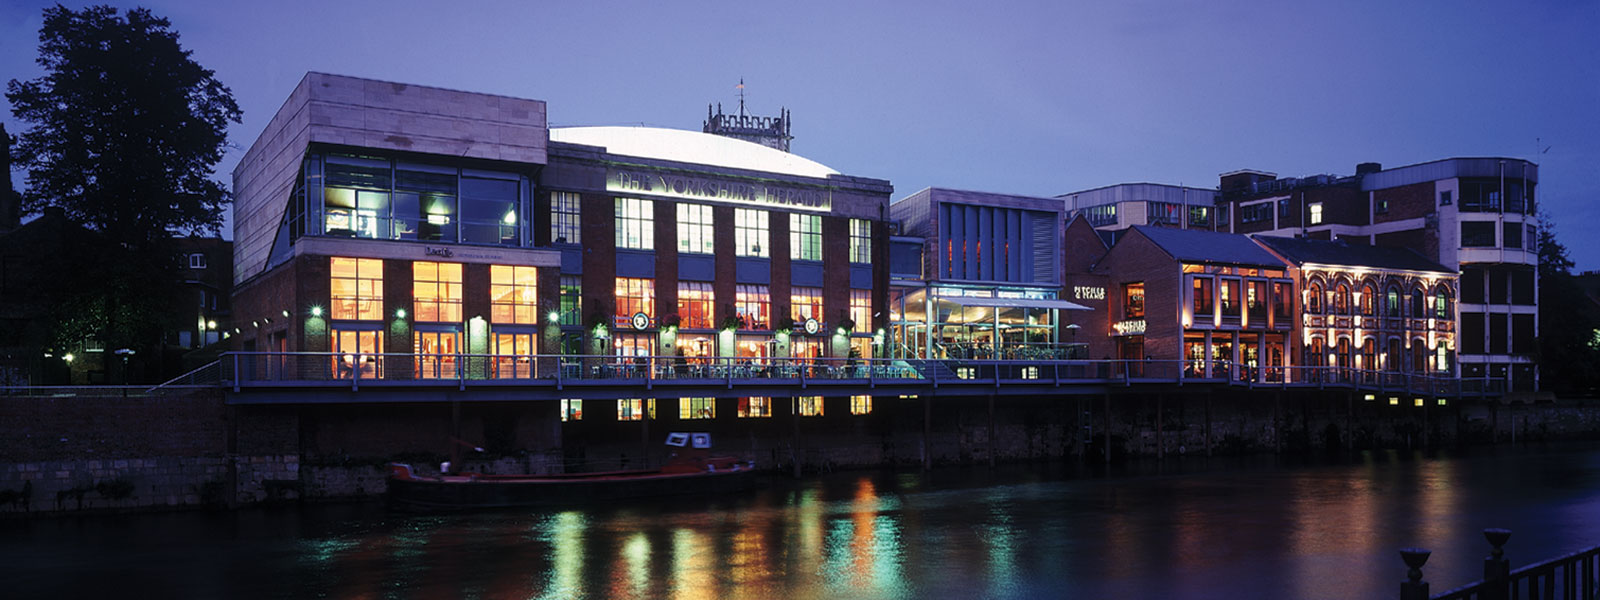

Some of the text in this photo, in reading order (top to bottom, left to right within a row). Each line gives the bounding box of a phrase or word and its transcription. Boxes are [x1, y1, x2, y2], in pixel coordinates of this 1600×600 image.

[616, 171, 824, 209] THE YORKSHIRE HERALD
